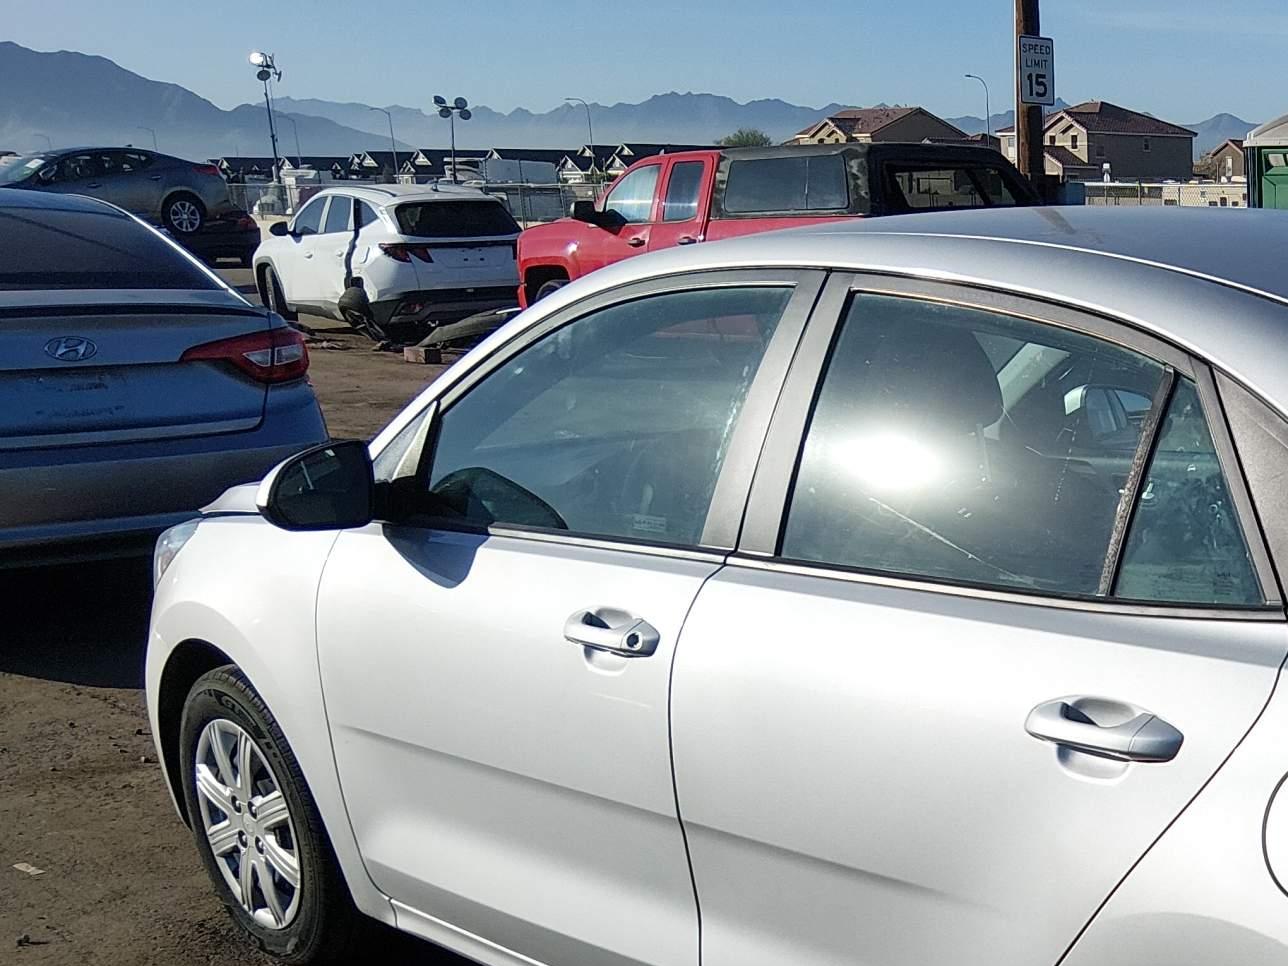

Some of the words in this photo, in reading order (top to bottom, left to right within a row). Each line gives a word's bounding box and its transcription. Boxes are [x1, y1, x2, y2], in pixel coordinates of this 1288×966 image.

[1022, 43, 1051, 55] SPEED
[1025, 58, 1048, 69] LIMIT
[1027, 72, 1048, 98] 15
